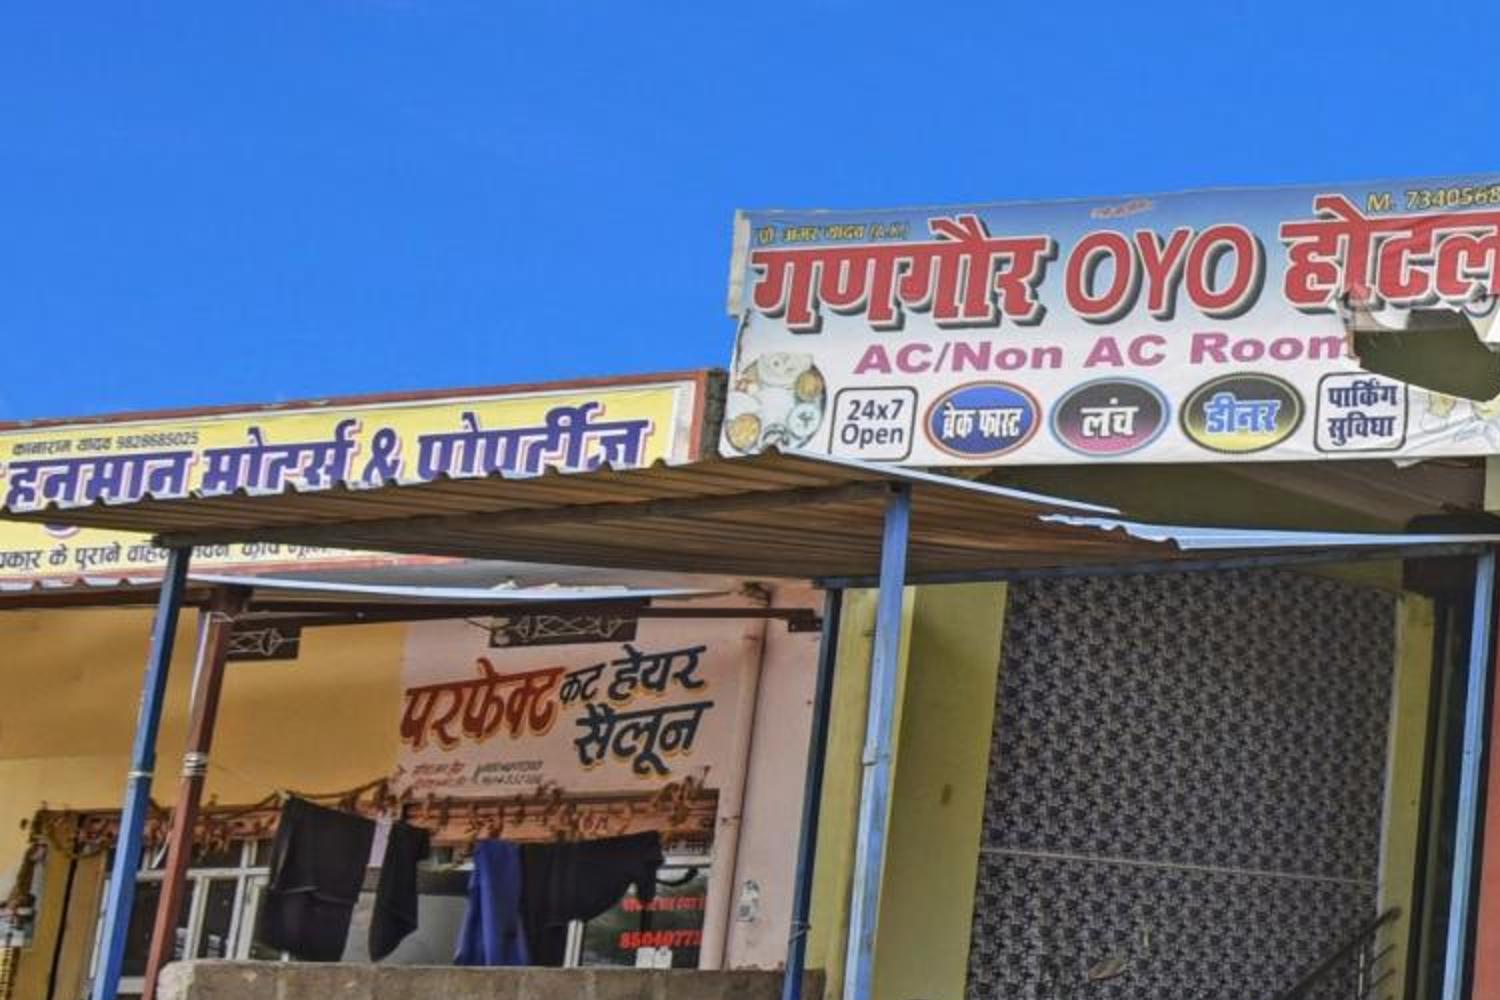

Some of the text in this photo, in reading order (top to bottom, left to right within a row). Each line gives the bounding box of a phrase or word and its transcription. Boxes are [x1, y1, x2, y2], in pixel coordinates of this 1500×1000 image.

[750, 214, 1056, 331] गणगौर
[1064, 226, 1264, 324] OYO
[853, 340, 1064, 375] AC/Non
[1084, 334, 1168, 368] AC
[846, 399, 904, 422] 24x7
[1080, 399, 1139, 438] लंच
[1203, 391, 1283, 434] डीनर
[840, 420, 904, 448] Open
[363, 427, 402, 486] &
[608, 644, 708, 701] हेयर
[574, 701, 715, 776] सैलून
